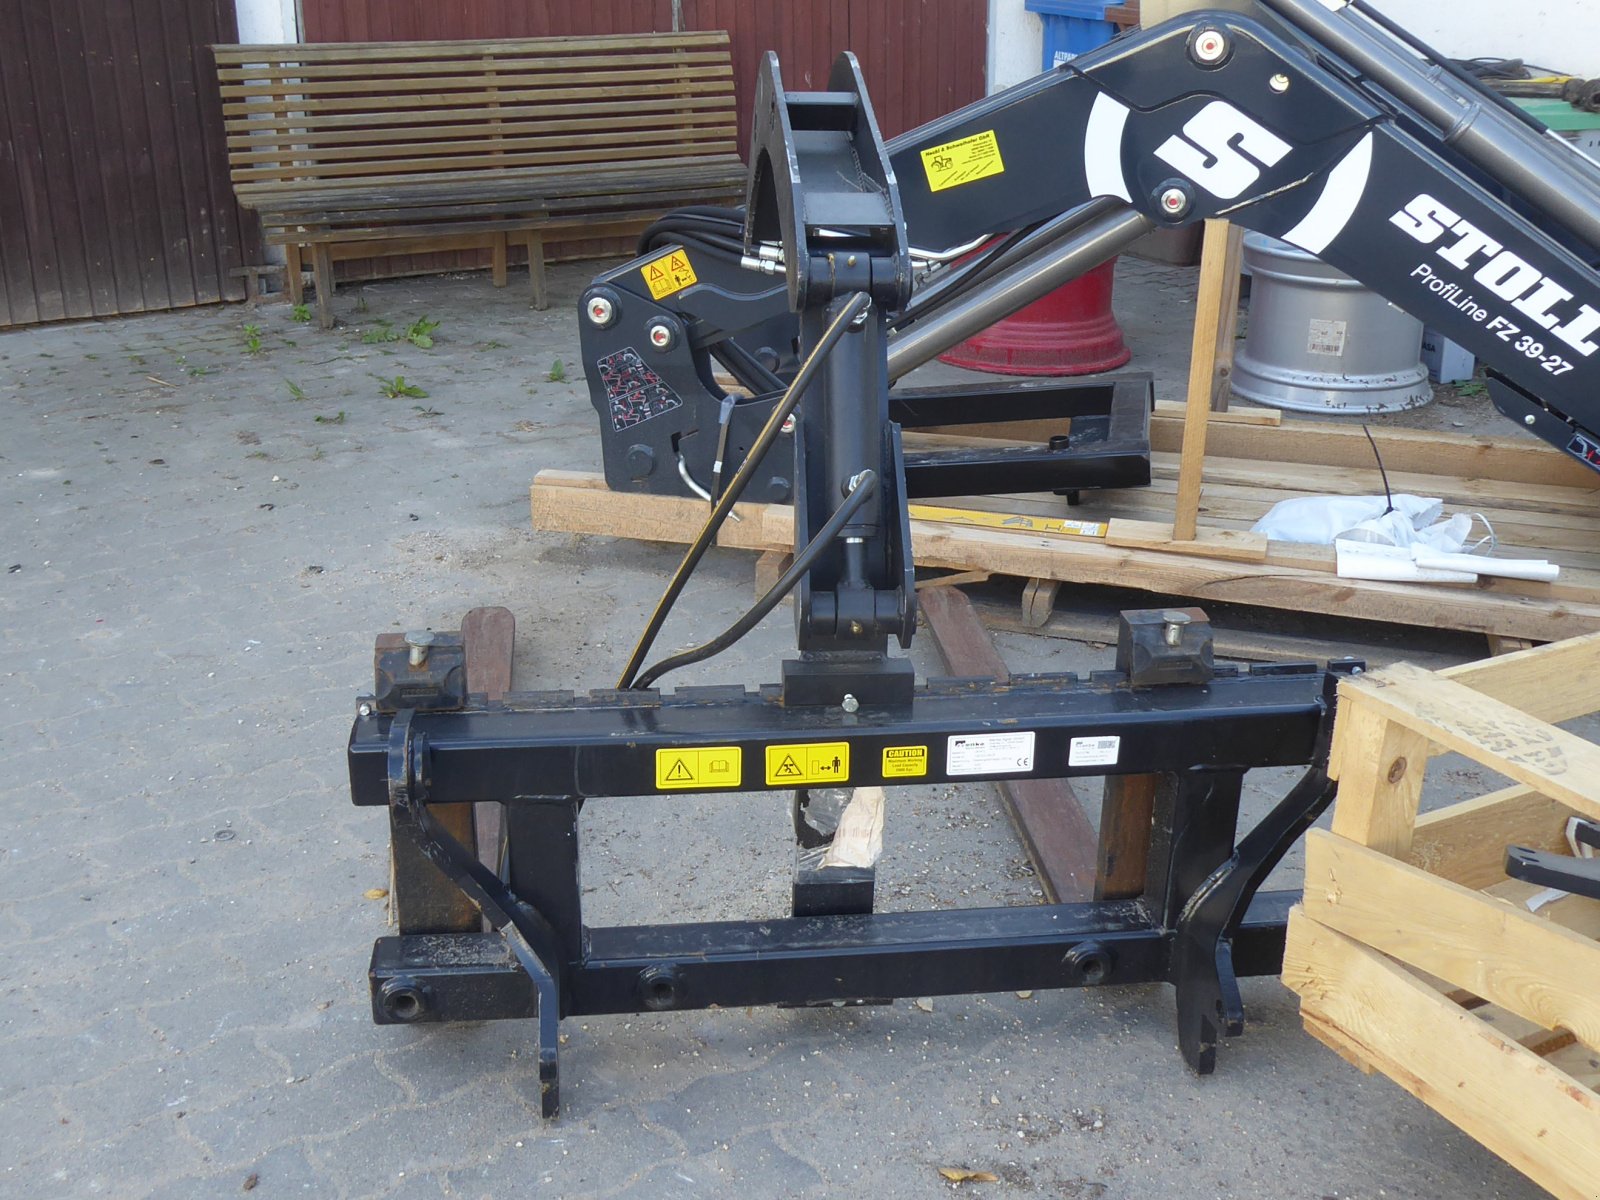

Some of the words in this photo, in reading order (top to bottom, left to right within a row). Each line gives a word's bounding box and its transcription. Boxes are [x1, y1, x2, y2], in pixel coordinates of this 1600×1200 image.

[1153, 100, 1293, 199] S
[1388, 193, 1600, 357] STOLL
[1410, 263, 1488, 322] ProfiLine
[1485, 315, 1521, 342] FZ
[1514, 335, 1574, 376] 39-27
[889, 749, 922, 758] CAUTION
